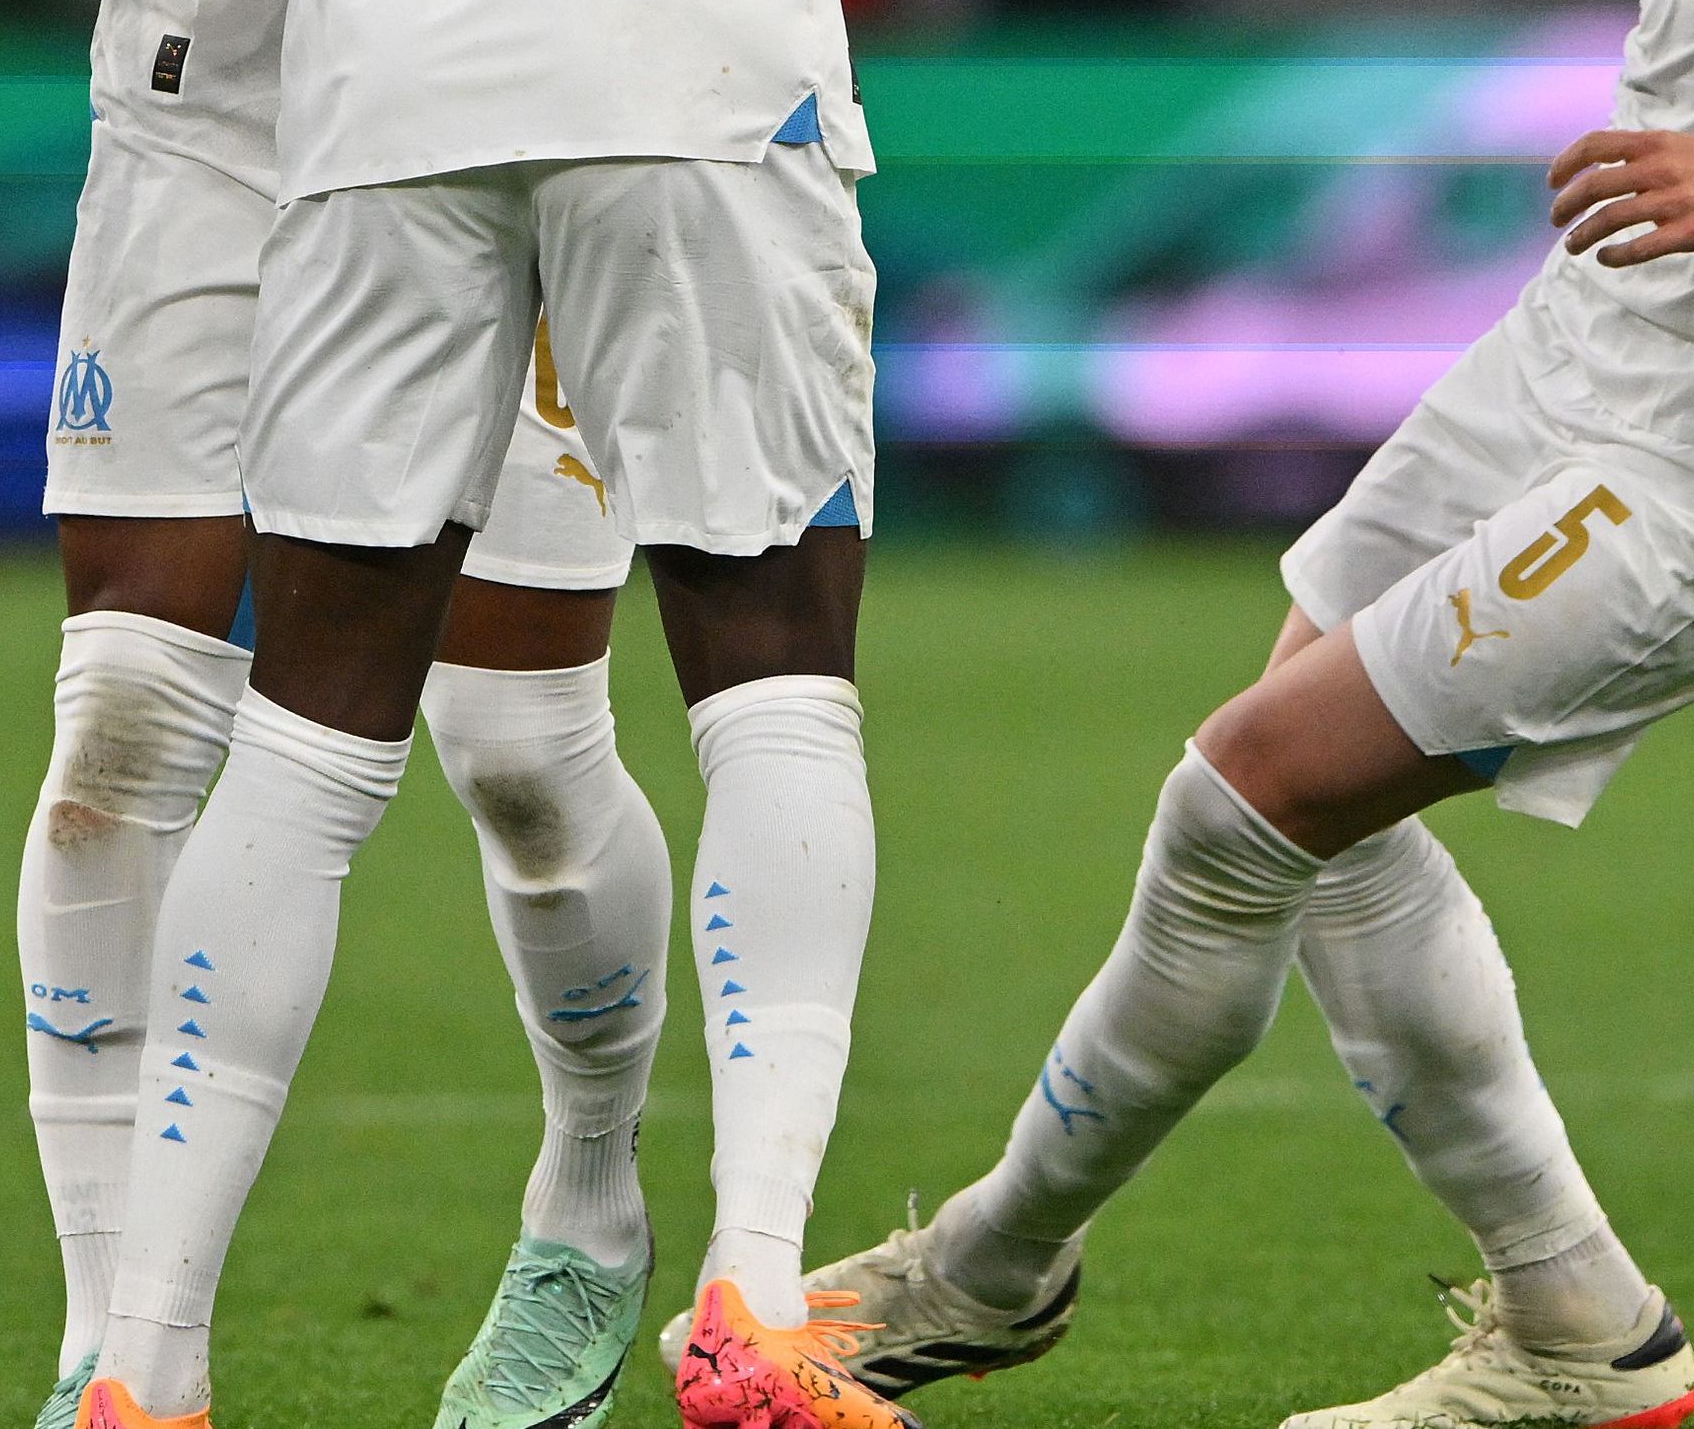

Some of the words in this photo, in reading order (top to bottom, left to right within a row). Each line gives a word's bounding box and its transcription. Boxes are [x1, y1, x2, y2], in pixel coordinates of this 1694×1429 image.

[90, 436, 112, 445] BUT
[1498, 483, 1633, 601] 5
[31, 983, 93, 1004] OM
[1539, 1379, 1581, 1395] COPA
